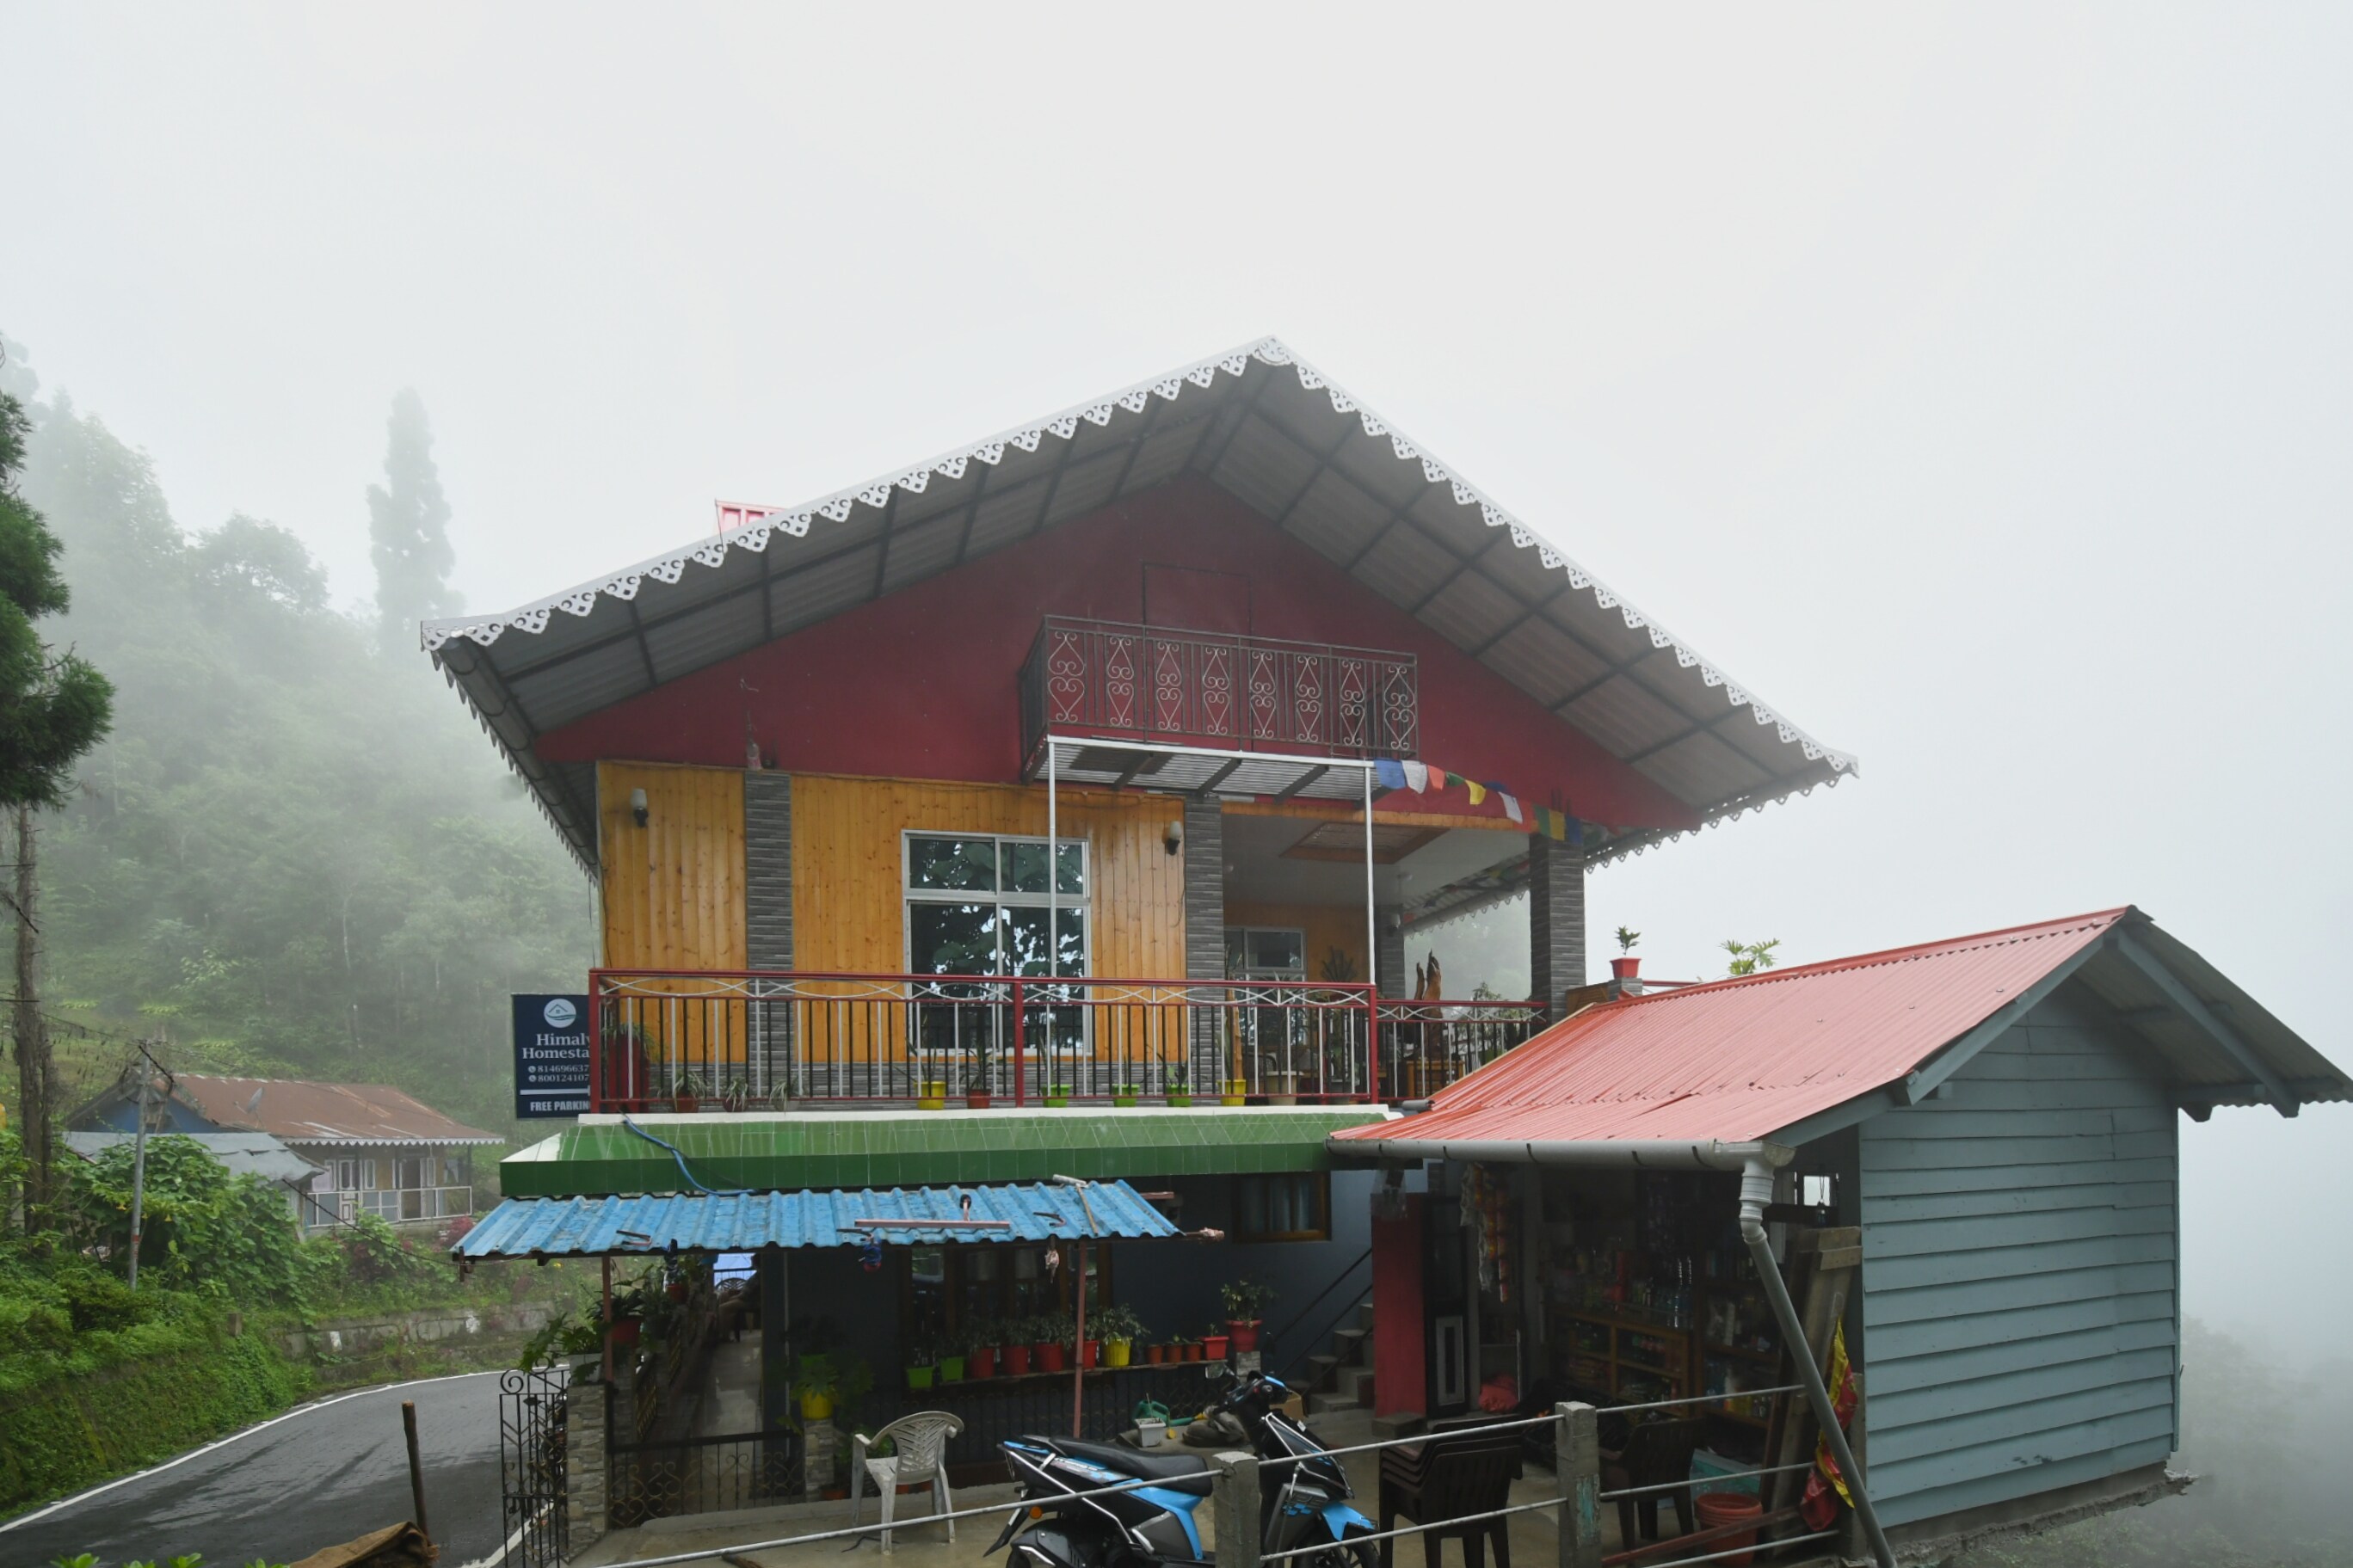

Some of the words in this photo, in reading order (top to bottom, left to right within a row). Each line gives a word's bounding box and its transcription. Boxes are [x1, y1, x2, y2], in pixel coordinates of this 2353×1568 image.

[522, 1048, 590, 1059] Homesta
[538, 1065, 589, 1073] 814696637
[538, 1073, 589, 1082] 800124107
[530, 1102, 552, 1111] FREE
[554, 1101, 590, 1111] PARKIN
